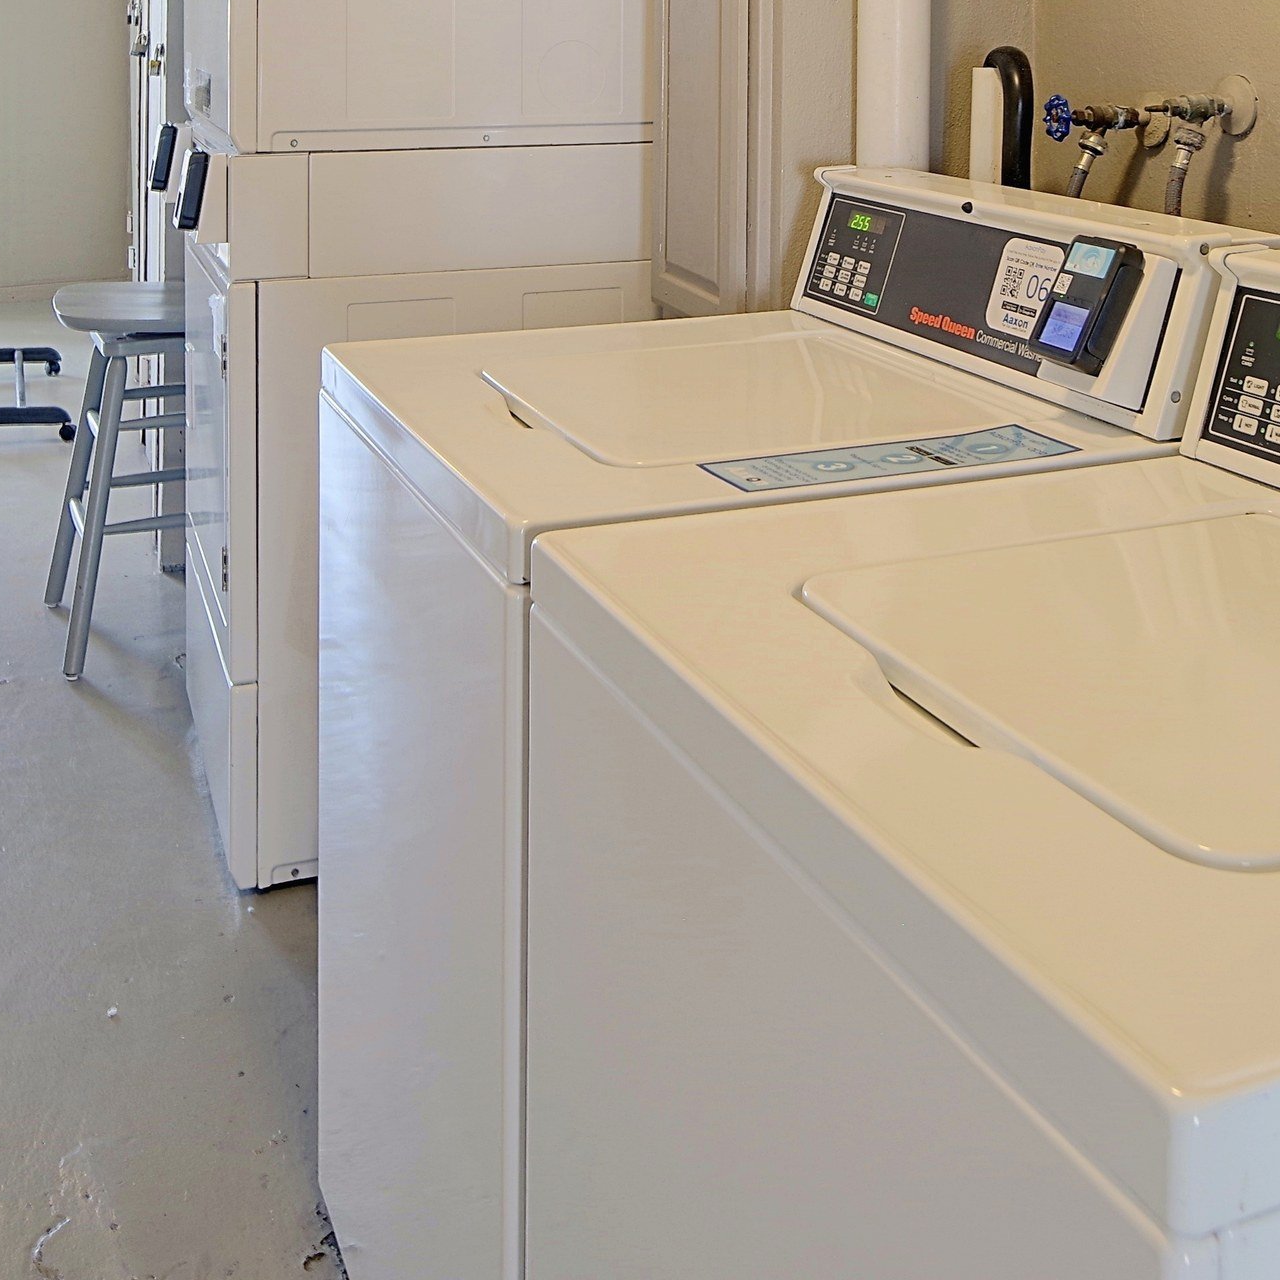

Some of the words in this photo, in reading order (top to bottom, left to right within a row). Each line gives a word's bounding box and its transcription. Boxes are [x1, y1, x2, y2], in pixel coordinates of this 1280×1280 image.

[1026, 274, 1052, 302] 06
[910, 306, 942, 328] Speed
[942, 316, 976, 340] Queen
[976, 329, 1018, 353] Commercial
[1002, 313, 1029, 329] Aaxon
